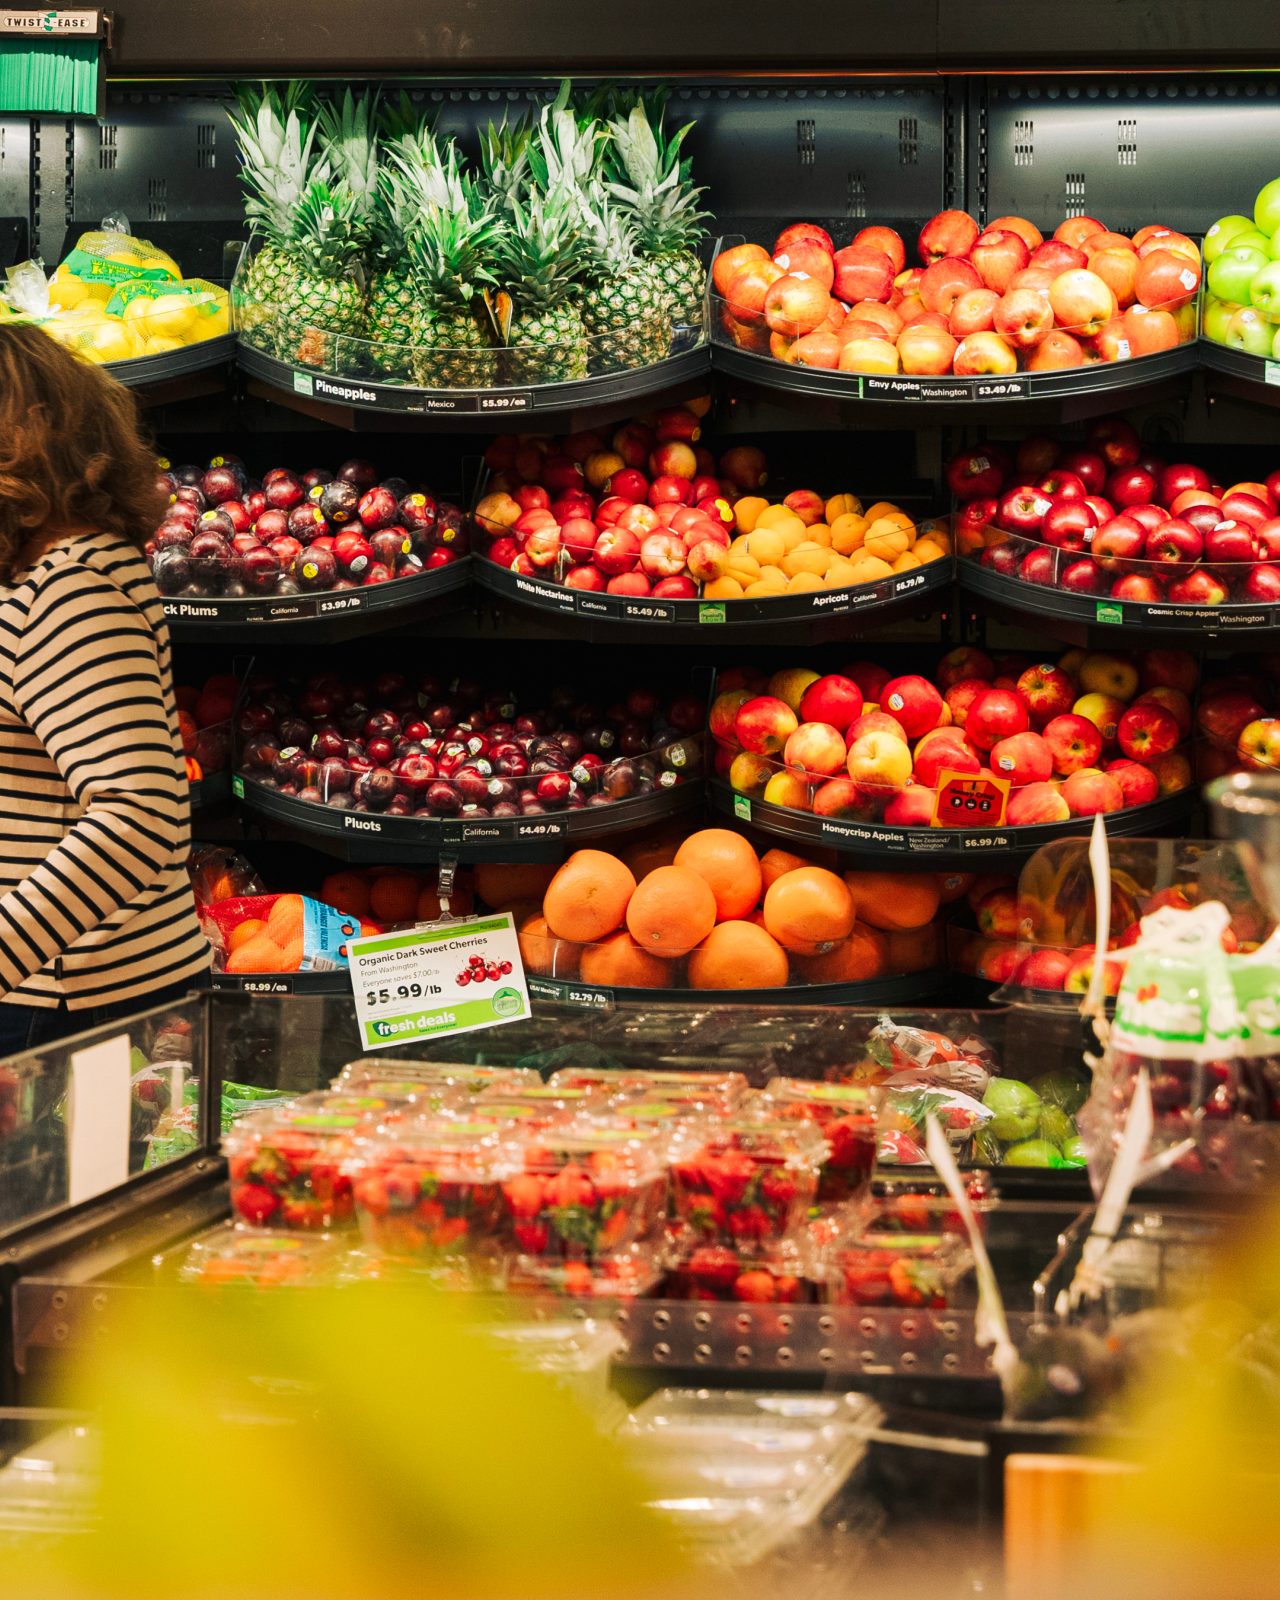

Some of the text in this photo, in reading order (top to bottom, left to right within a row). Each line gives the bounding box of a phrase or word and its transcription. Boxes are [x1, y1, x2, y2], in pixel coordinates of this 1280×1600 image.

[7, 18, 41, 27] TWIST
[869, 380, 920, 391] Envy Apples
[978, 385, 1006, 394] $3.49
[315, 380, 377, 402] Pineapples
[922, 388, 967, 398] Washington
[428, 400, 455, 408] Mexico
[482, 399, 508, 408] $5.99
[516, 579, 574, 602] White Nectarines
[813, 593, 849, 606] Apricots
[852, 593, 878, 603] California
[180, 604, 218, 616] Plums
[270, 606, 299, 615] California
[321, 600, 346, 611] $3.99
[581, 601, 607, 611] California
[626, 606, 652, 617] $5.49
[1147, 607, 1219, 618] Cosmic Crisp Apples
[1220, 615, 1265, 624] Washington
[344, 816, 382, 832] Pluots
[464, 828, 500, 836] California
[519, 826, 546, 834] $4.49
[822, 822, 904, 842] Honeycrisp Apples
[965, 838, 992, 848] $6.99
[358, 937, 488, 967] Organic Dark Sweet Cherries
[360, 961, 418, 977] From Washington
[244, 982, 288, 992] $8.99 /ea
[362, 977, 392, 989] Everyone
[569, 992, 592, 1001] $2.79
[377, 1019, 416, 1036] fresh
[416, 1011, 456, 1028] deals
